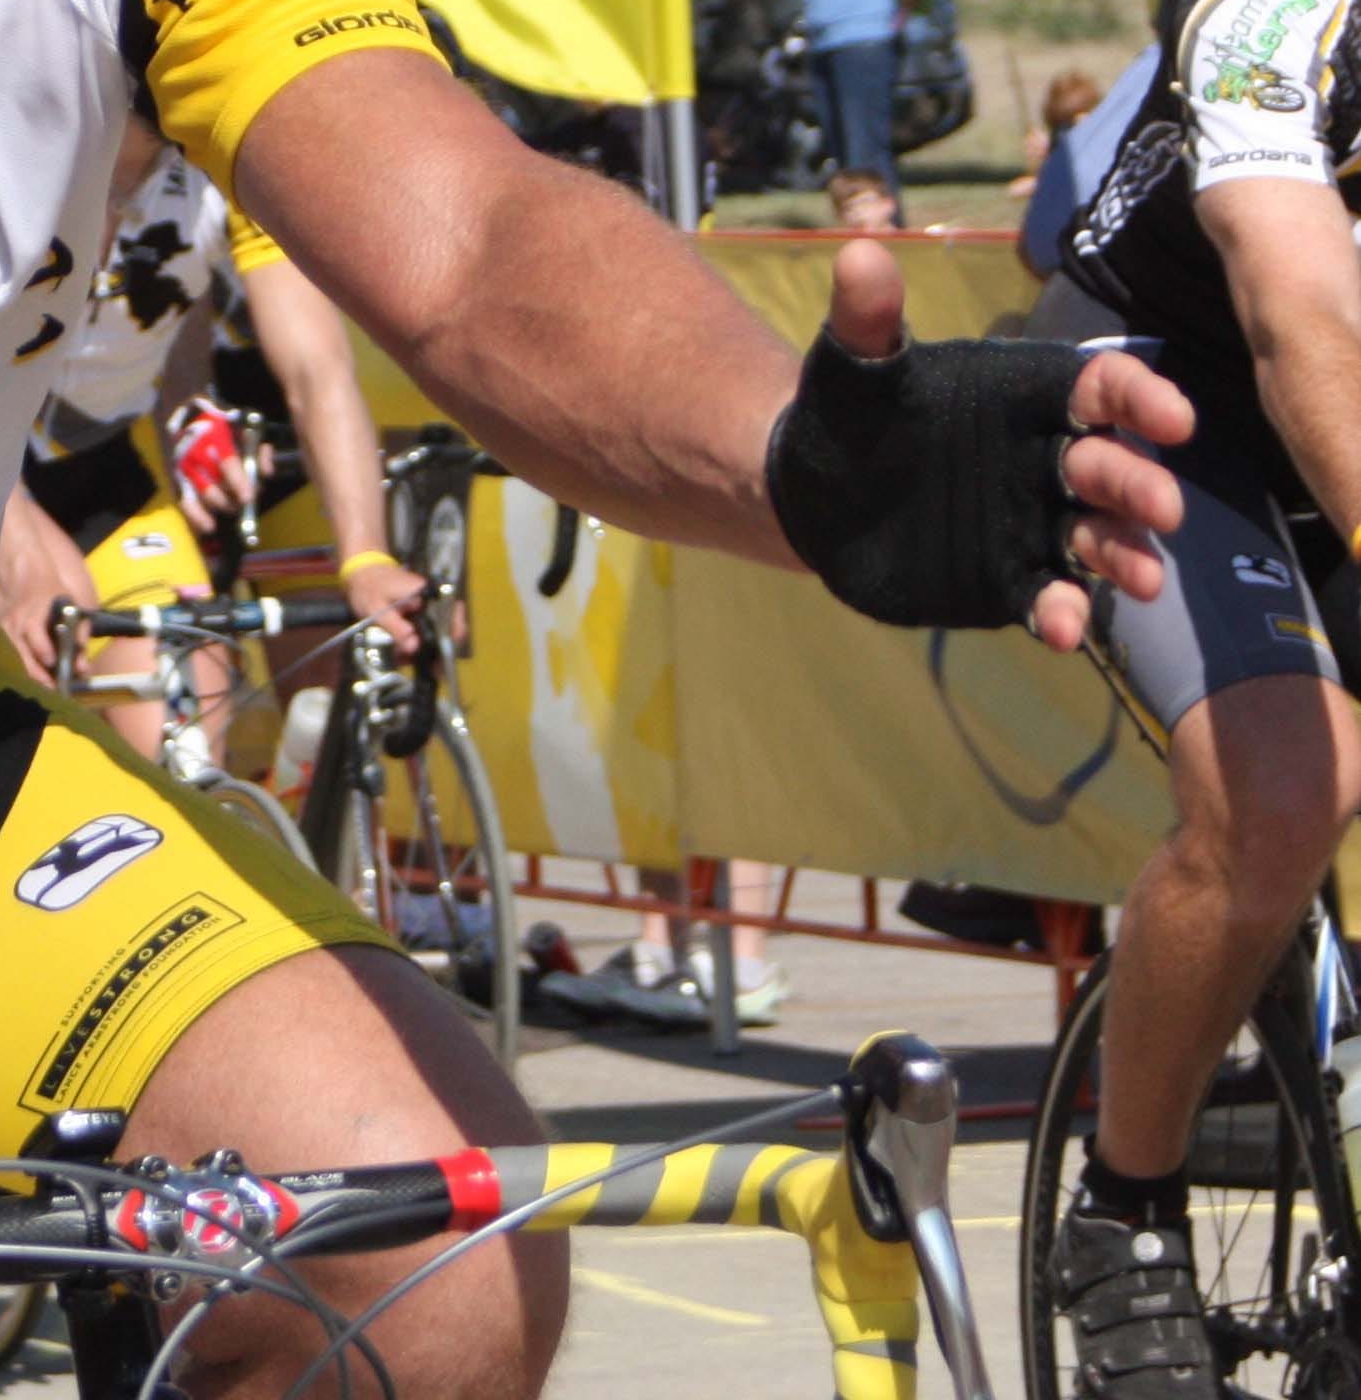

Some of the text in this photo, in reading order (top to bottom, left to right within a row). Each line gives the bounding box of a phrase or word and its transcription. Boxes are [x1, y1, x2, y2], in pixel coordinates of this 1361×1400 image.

[44, 909, 201, 1091] LIVESTRONG
[56, 916, 222, 1105] LANCE ARMSTRONG FOUNDATION
[61, 947, 126, 1027] SUPPORTING
